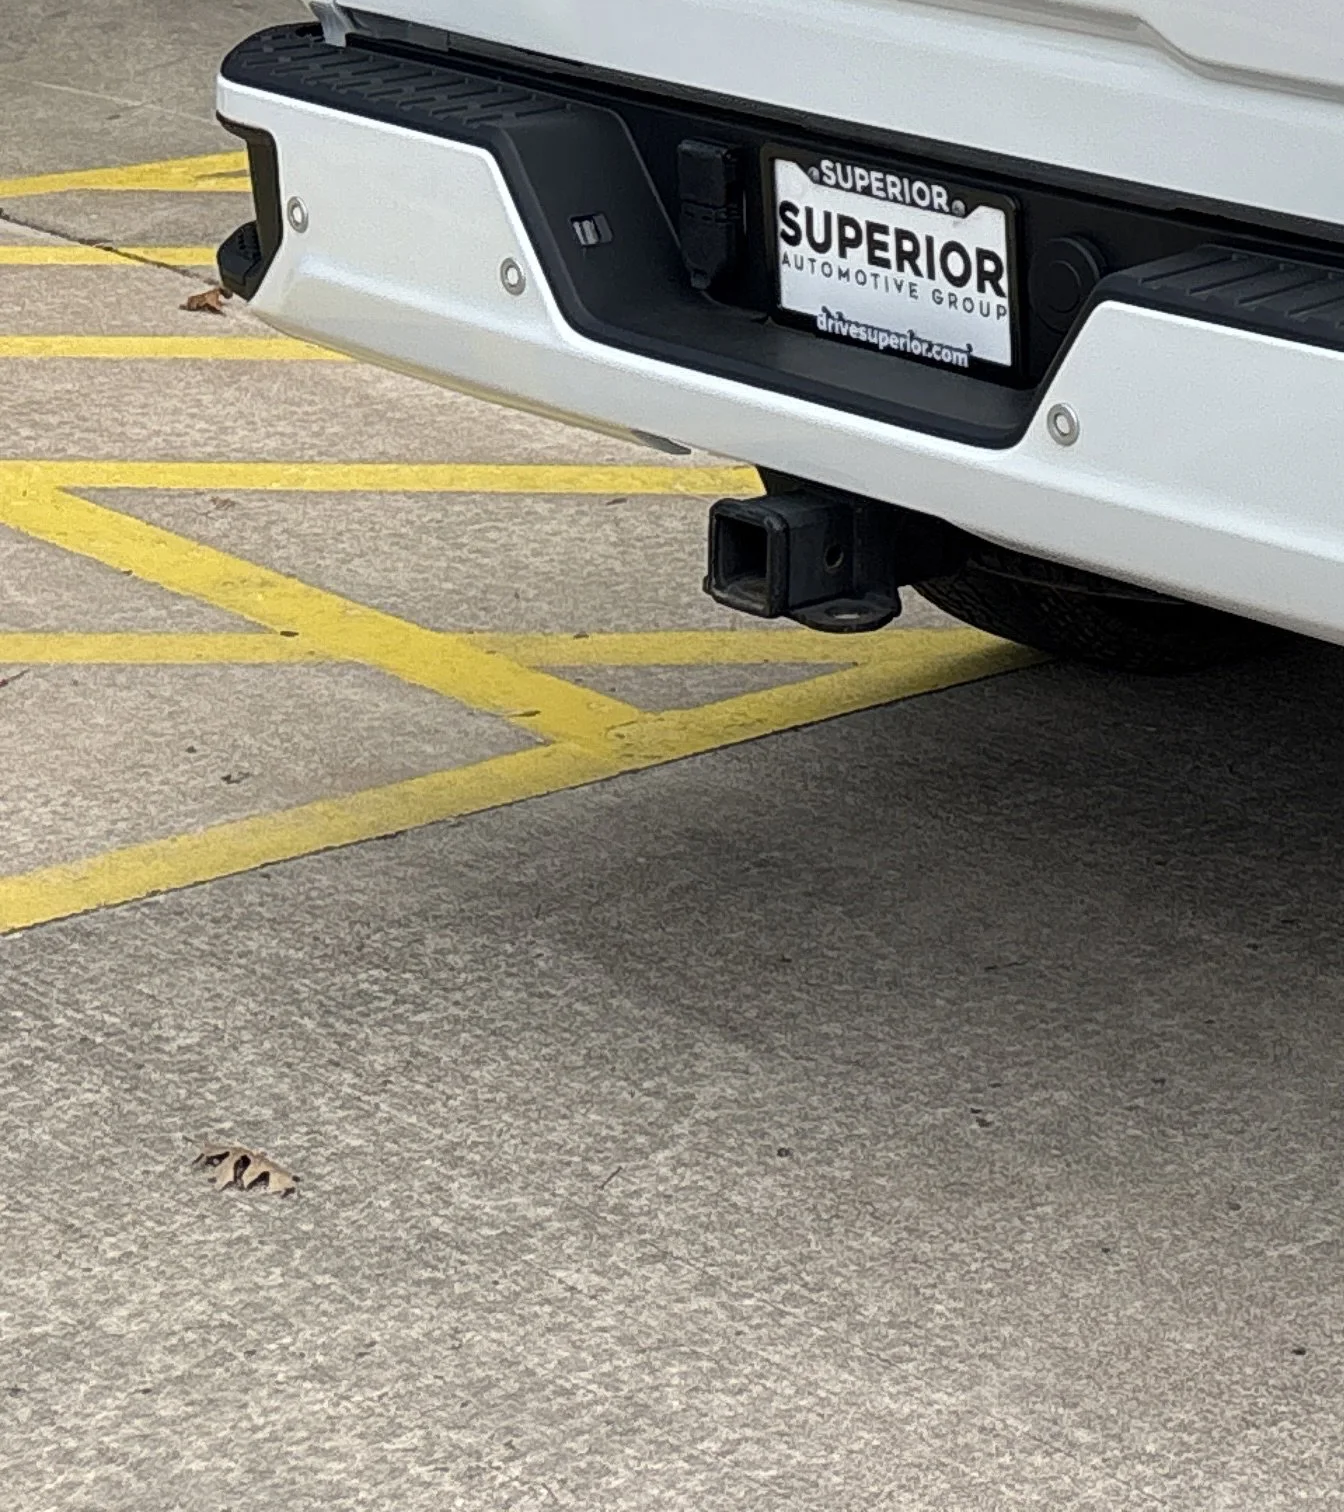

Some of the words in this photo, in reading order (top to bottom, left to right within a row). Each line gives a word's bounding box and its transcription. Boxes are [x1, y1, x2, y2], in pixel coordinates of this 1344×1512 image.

[821, 159, 950, 213] SUPERIOR
[778, 200, 1007, 299] SUPERIOR
[781, 251, 920, 300] AUTOMOTIVE
[931, 288, 1008, 321] GROUP
[816, 310, 970, 368] drivesuperior.com
